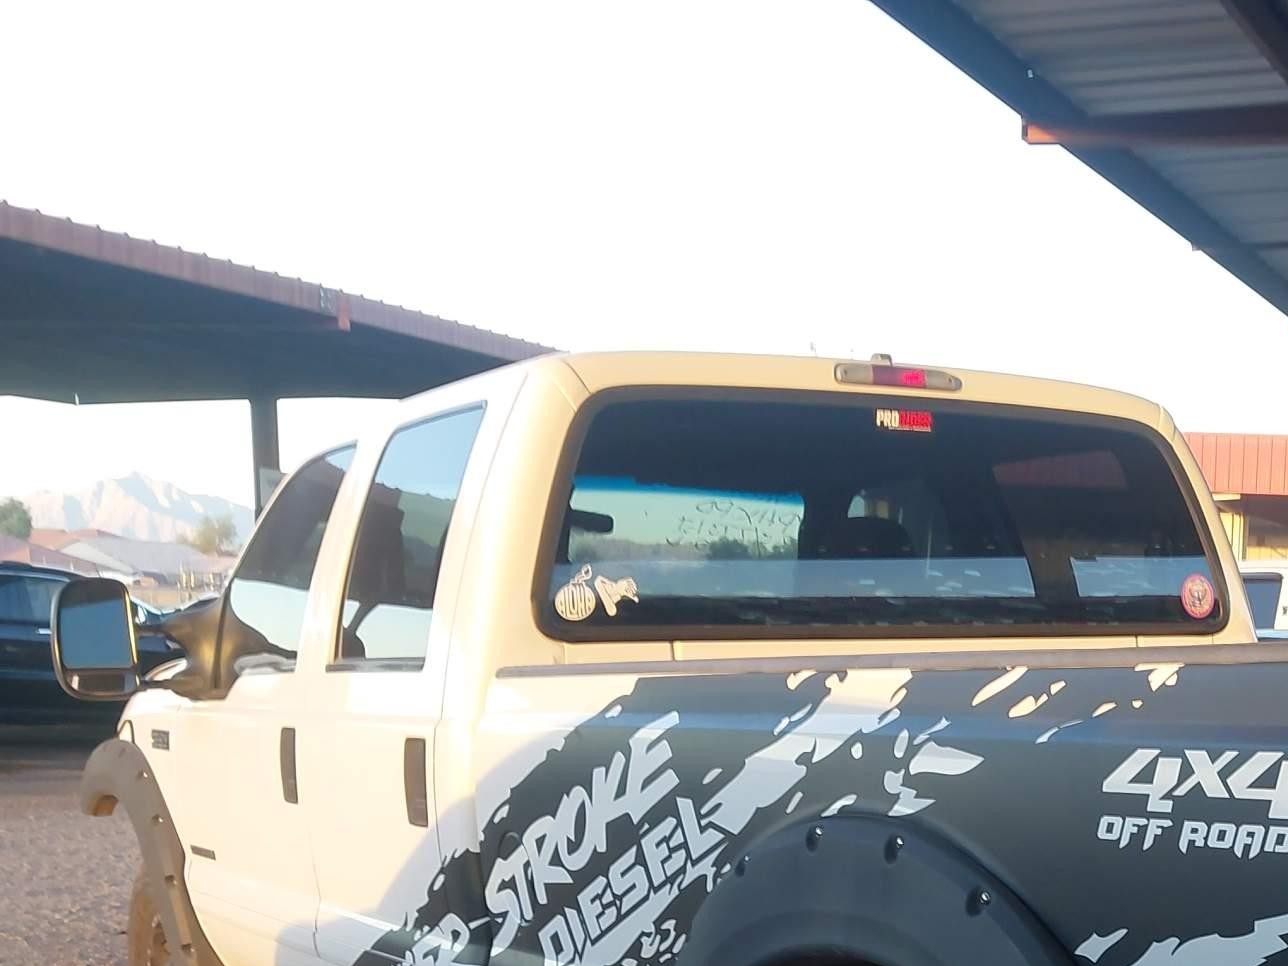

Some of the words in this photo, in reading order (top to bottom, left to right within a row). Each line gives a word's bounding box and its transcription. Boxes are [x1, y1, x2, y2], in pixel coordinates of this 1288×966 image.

[557, 583, 595, 618] ALOHA
[485, 711, 681, 957] STROKE
[1096, 814, 1175, 852] OFF
